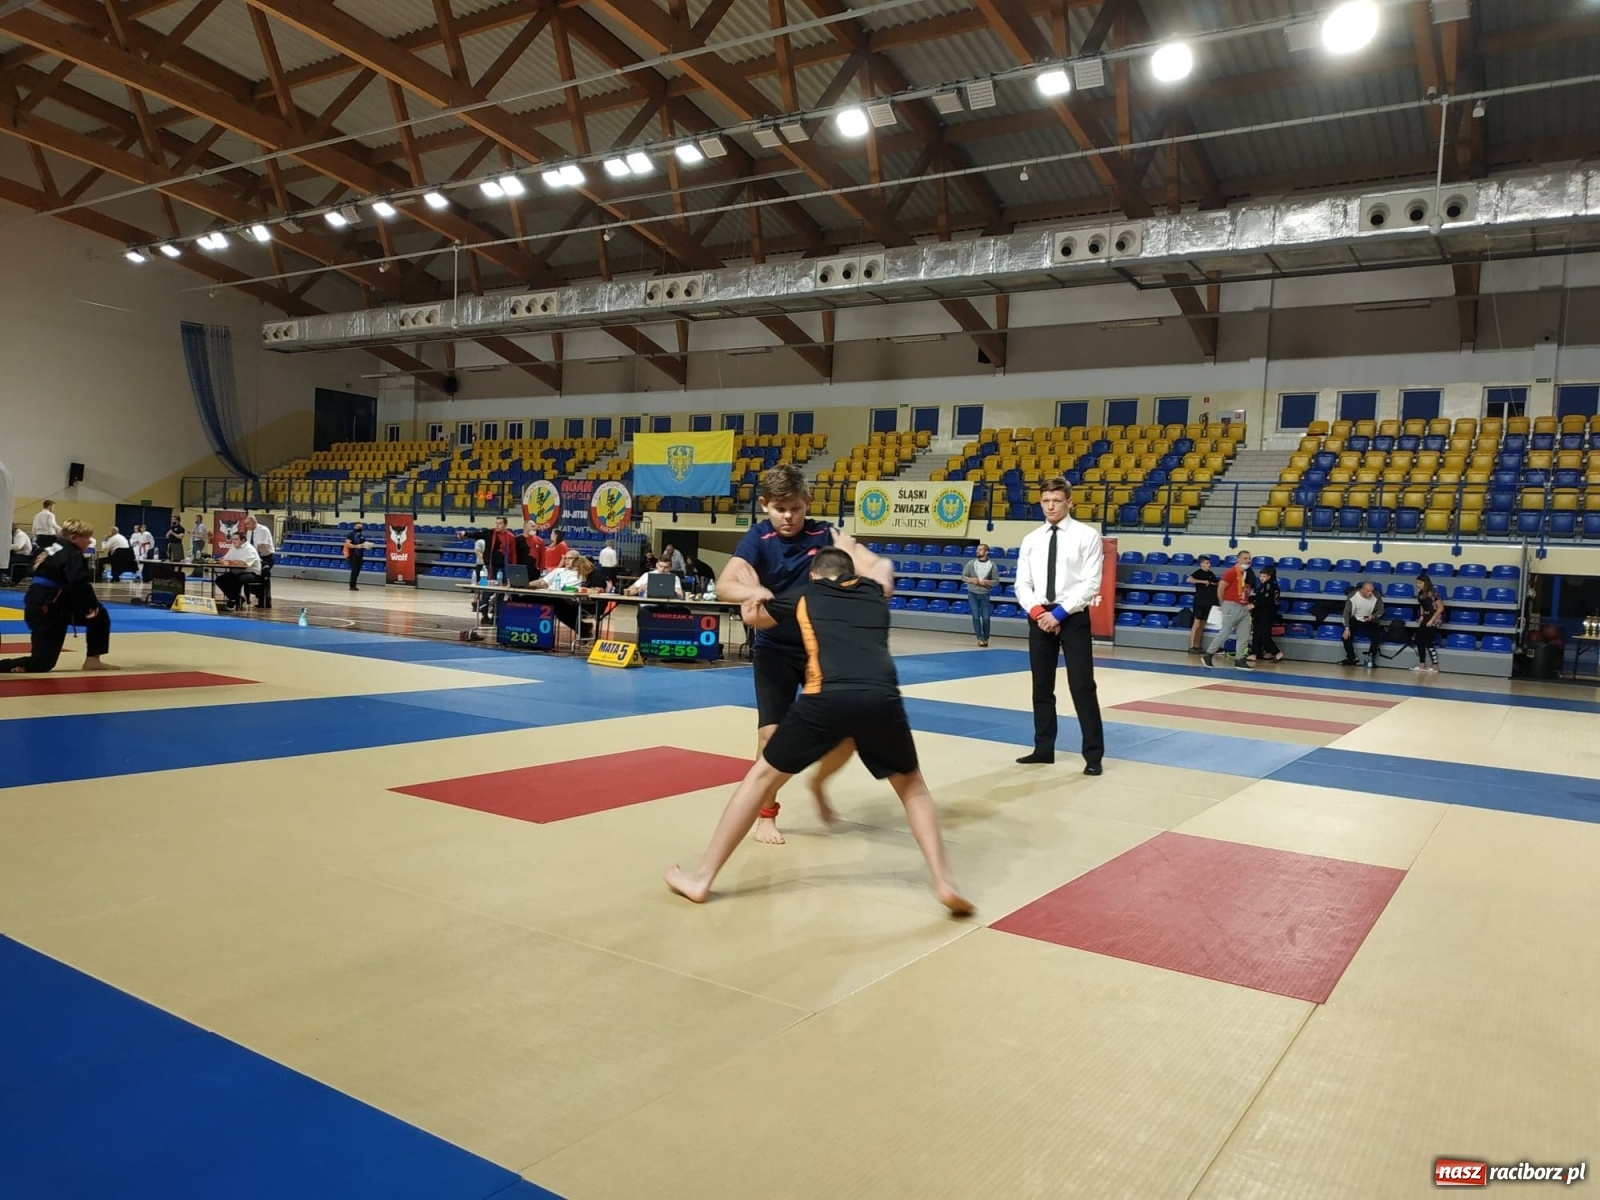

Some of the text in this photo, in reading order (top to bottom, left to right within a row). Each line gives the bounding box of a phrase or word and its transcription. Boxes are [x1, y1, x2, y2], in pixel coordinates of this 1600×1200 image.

[561, 492, 591, 500] FIGHT CLUB
[898, 487, 927, 501] ŚLĄSKI
[561, 510, 589, 519] JU-JITSU
[893, 504, 930, 516] ZWIĄZEK
[892, 519, 930, 528] JU-JITSU
[540, 605, 551, 619] 2
[540, 619, 551, 634] 0
[700, 616, 716, 630] 0
[511, 631, 538, 644] 2:03
[700, 631, 715, 645] 0
[598, 642, 620, 654] MATA
[617, 644, 629, 661] 5
[658, 645, 698, 657] 2:59
